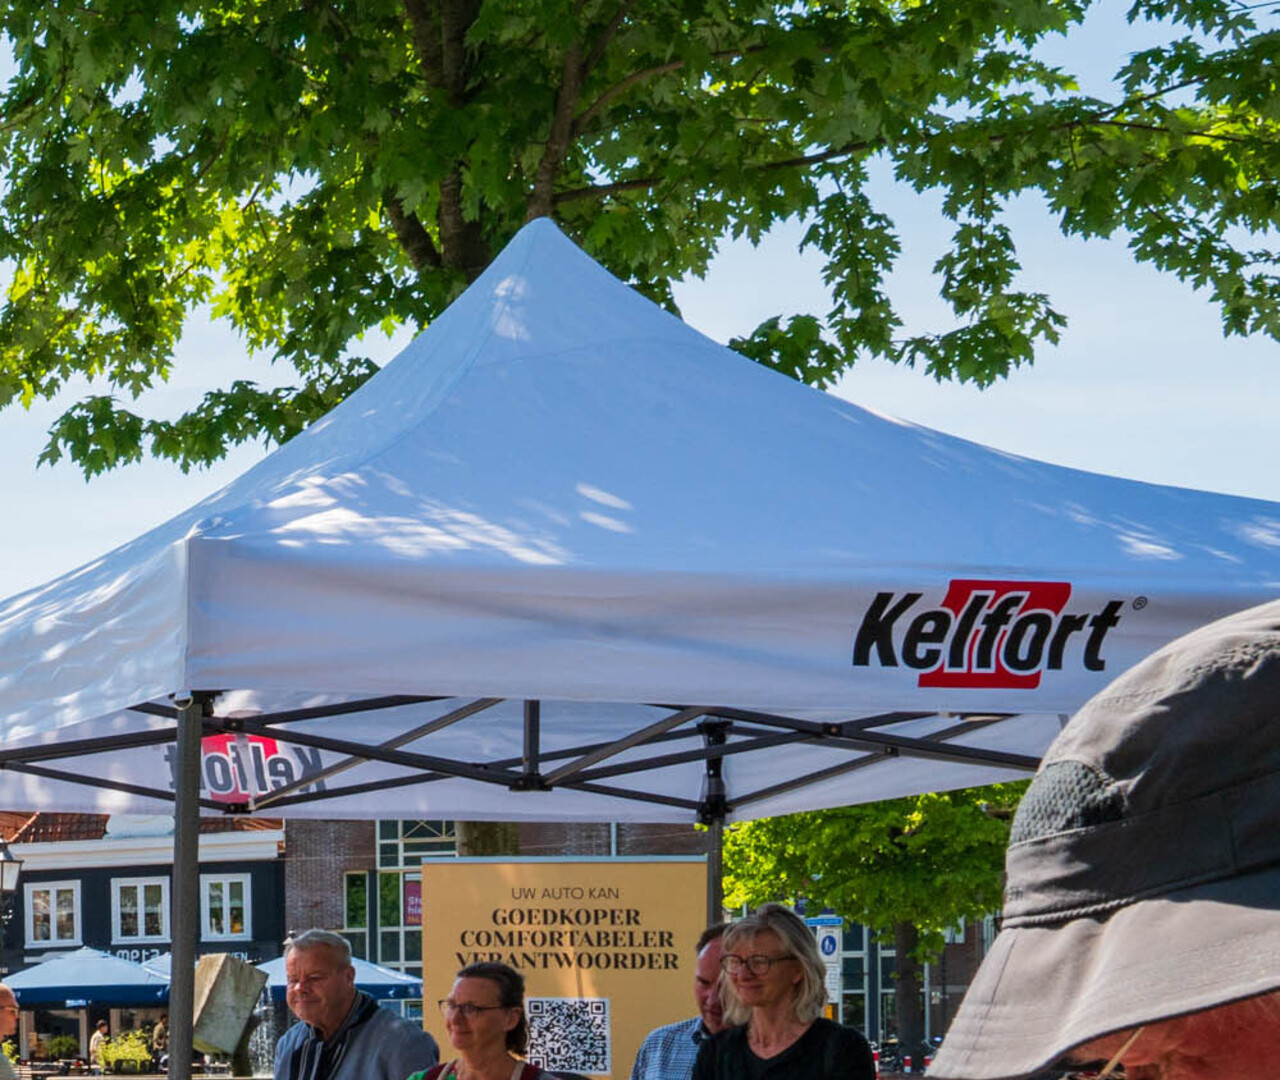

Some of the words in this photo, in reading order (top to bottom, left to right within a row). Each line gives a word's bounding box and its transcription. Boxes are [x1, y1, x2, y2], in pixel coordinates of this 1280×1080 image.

[511, 887, 536, 900] UW
[541, 887, 584, 900] AUTO
[588, 887, 619, 900] KAN
[492, 908, 642, 926] GOEDKOPER
[460, 930, 675, 948] COMFORTABELER
